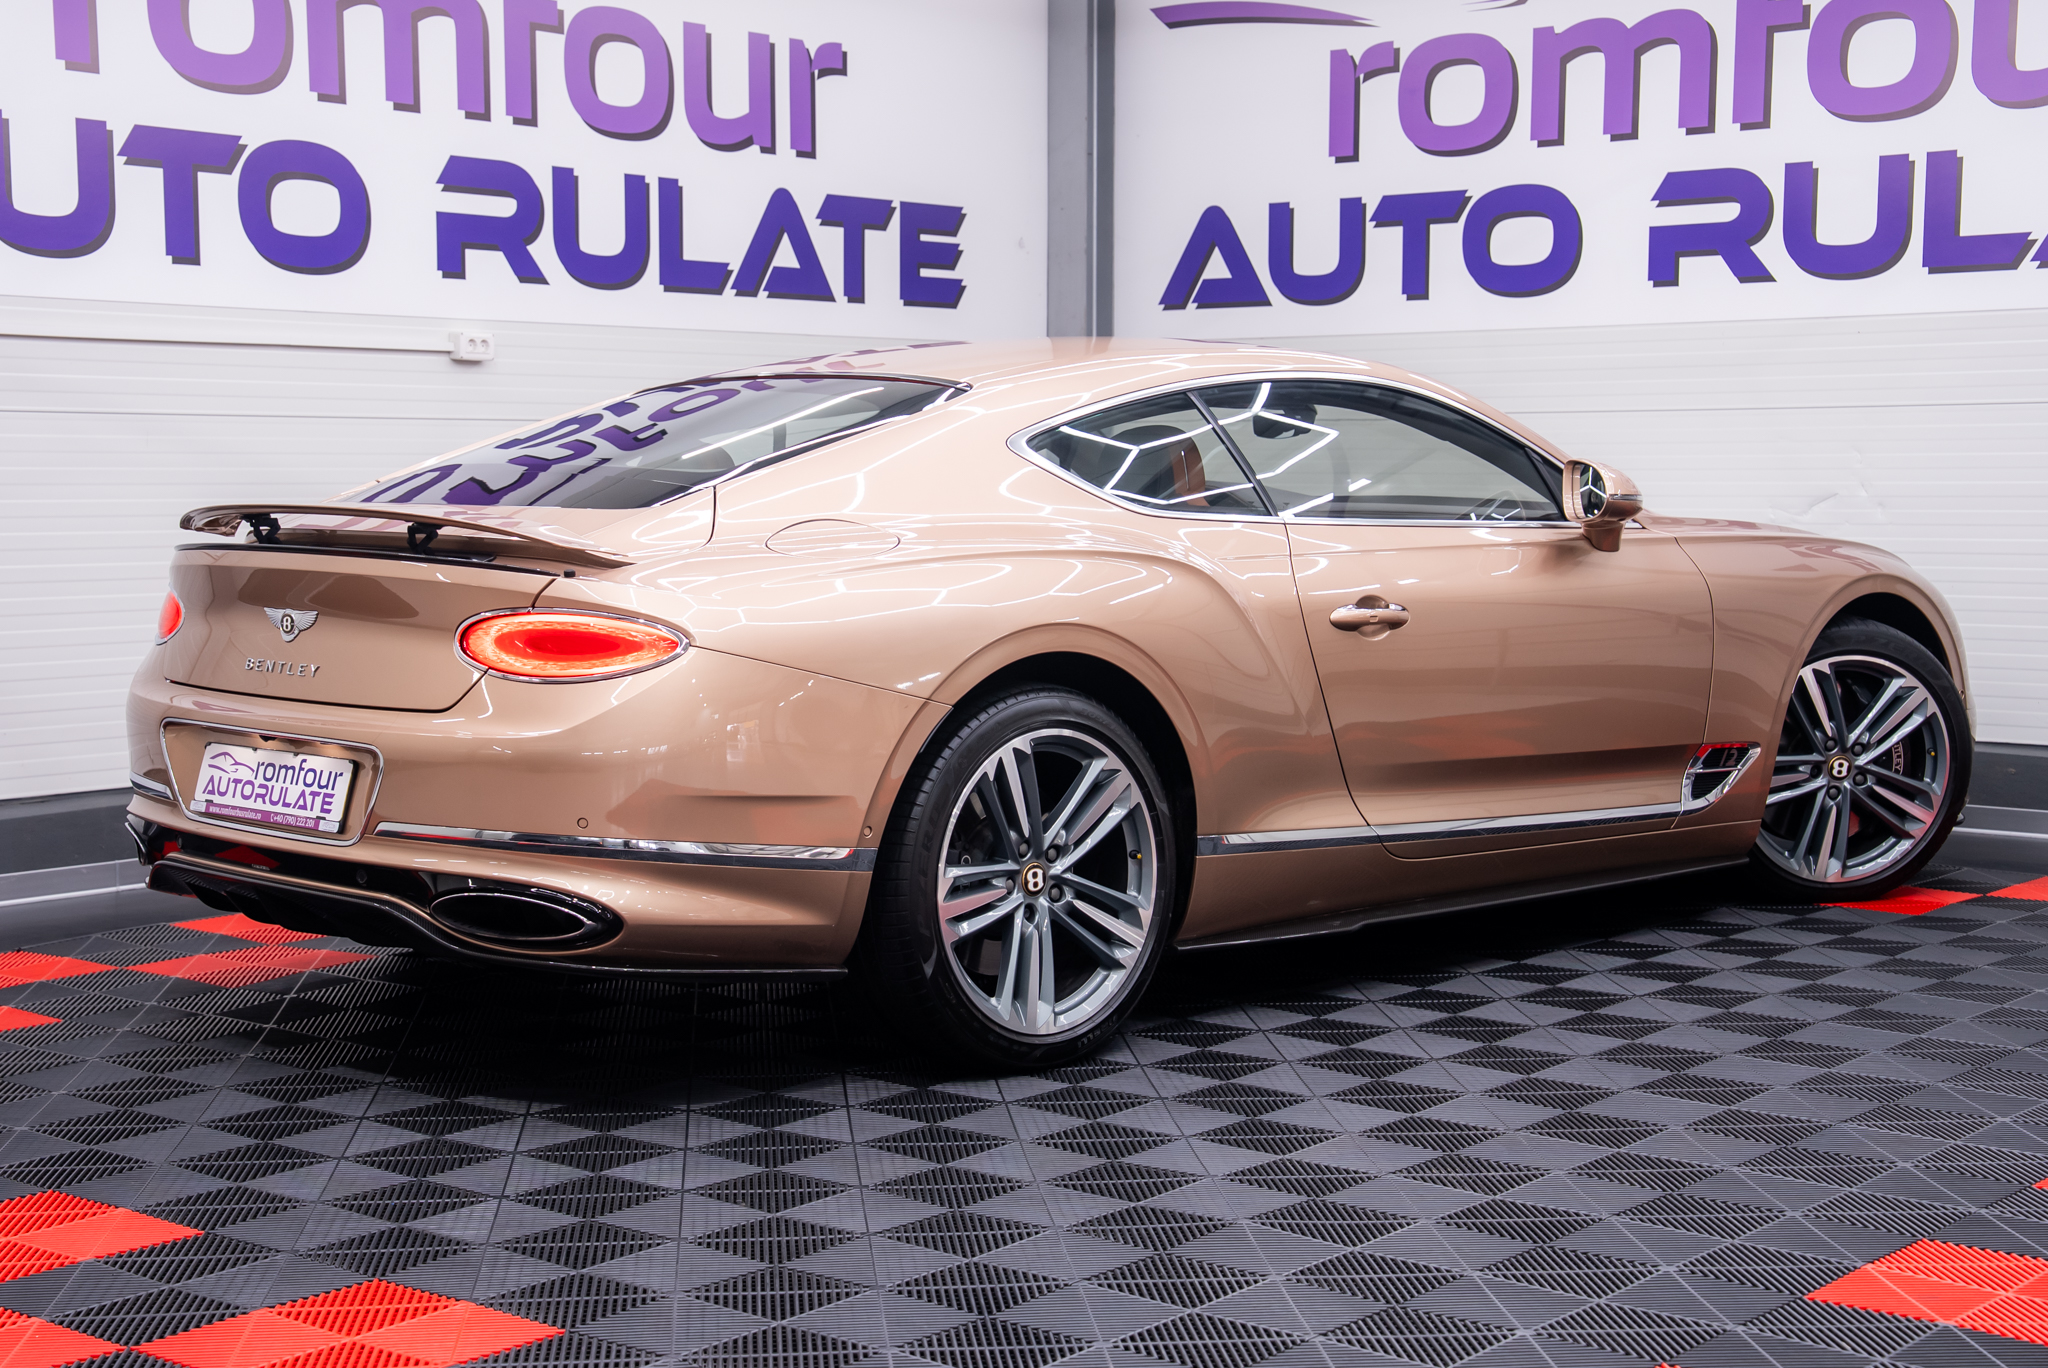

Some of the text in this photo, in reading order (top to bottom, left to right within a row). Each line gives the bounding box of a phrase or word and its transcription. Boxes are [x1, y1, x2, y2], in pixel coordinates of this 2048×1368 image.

[435, 154, 967, 308] RULATE
[1159, 150, 2048, 310] AUTO RUL
[245, 657, 320, 678] BENTLEY
[254, 758, 343, 792] romfour
[202, 774, 336, 815] AUTORULATE
[296, 817, 305, 827] 222
